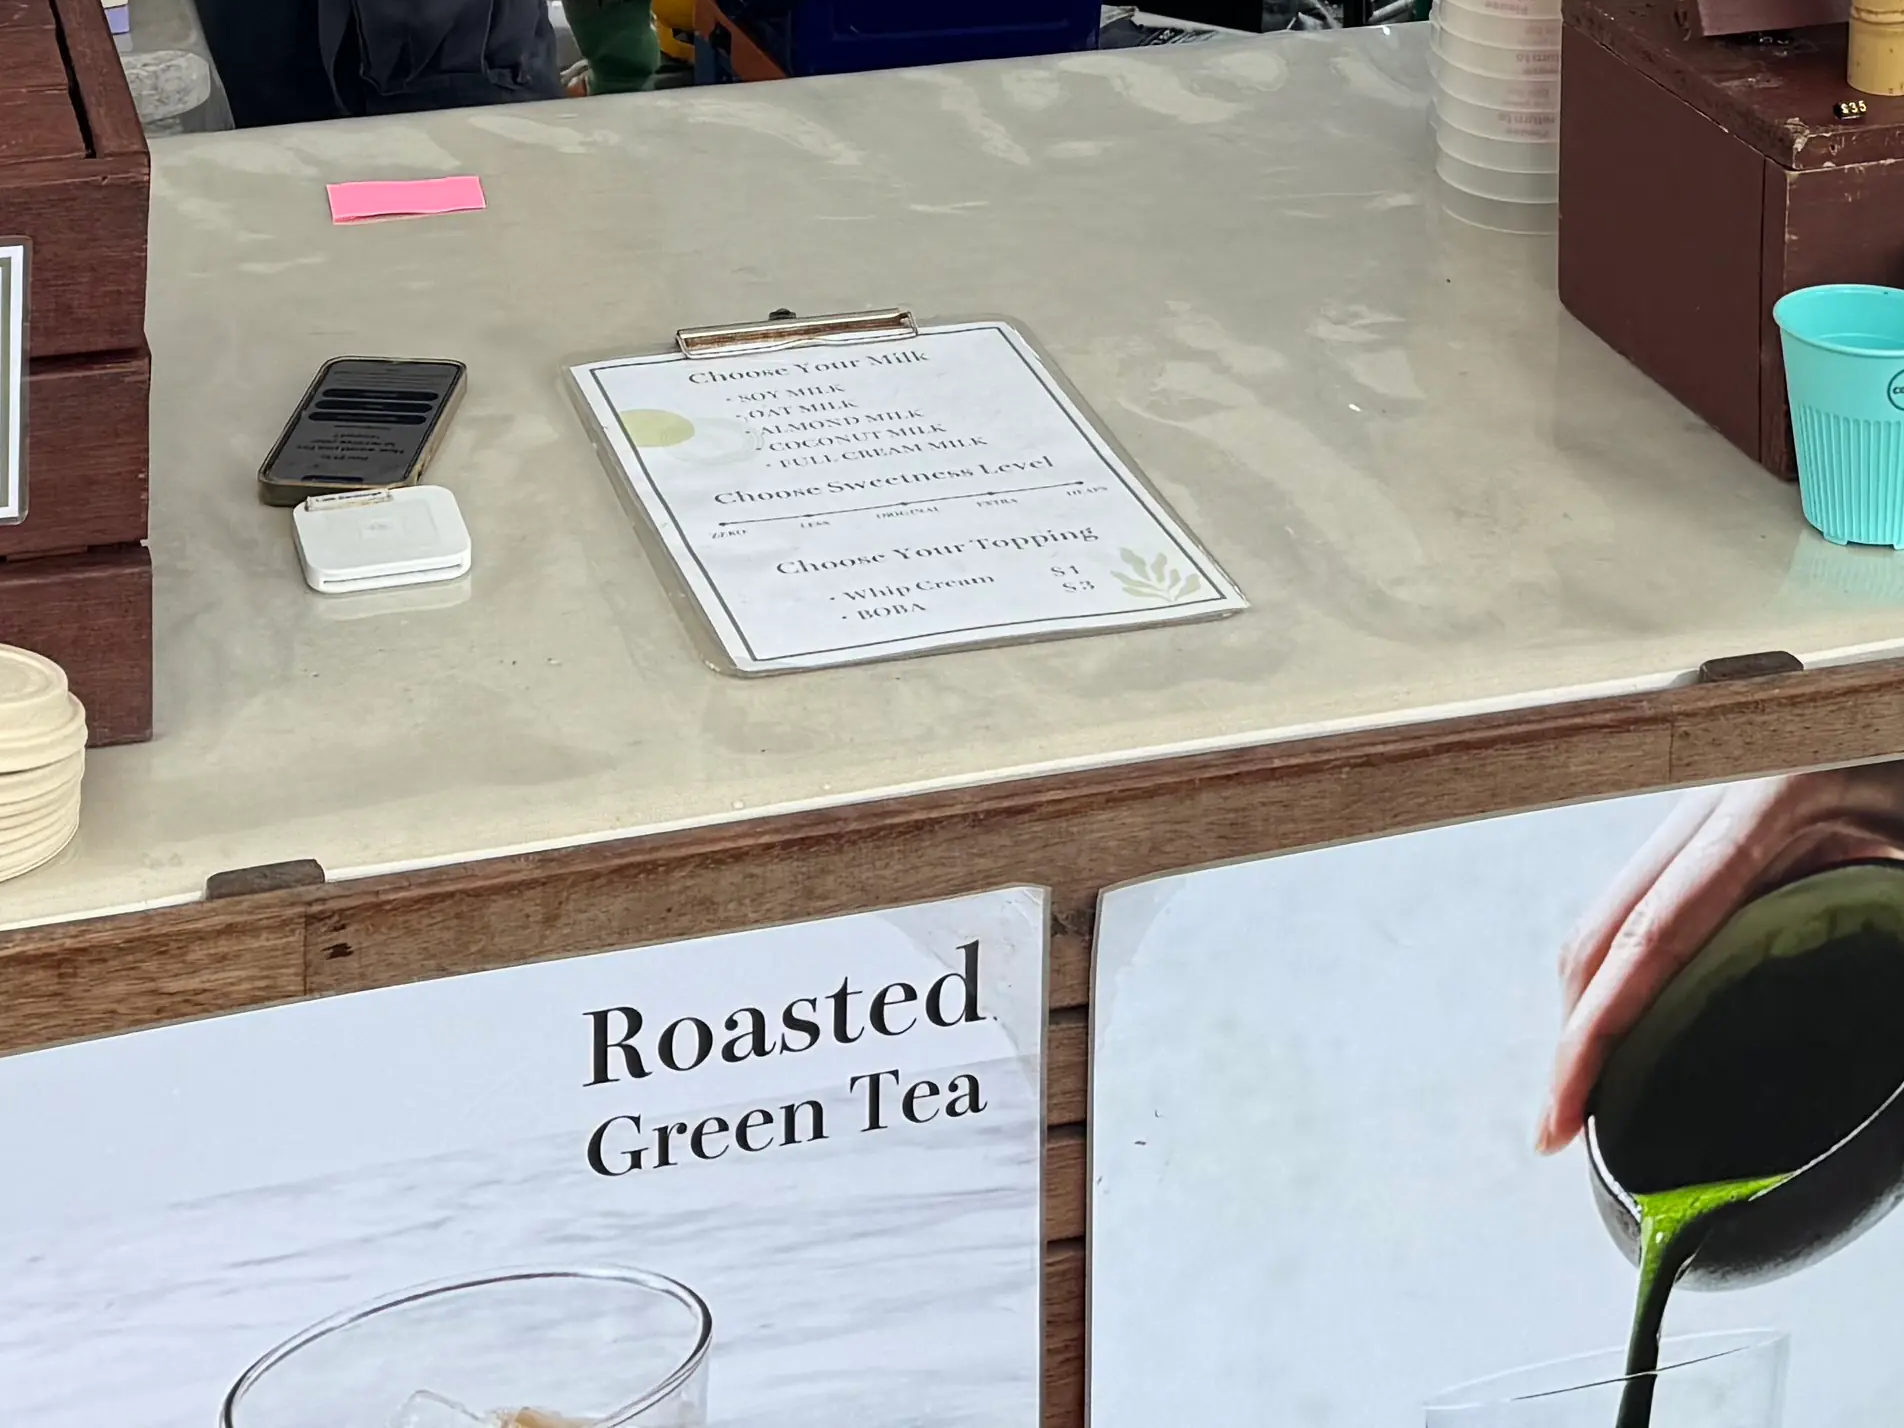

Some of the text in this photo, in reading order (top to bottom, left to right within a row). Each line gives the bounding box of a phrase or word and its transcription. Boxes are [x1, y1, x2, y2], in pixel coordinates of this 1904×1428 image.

[688, 350, 930, 385] Choose Your Milk
[714, 455, 1055, 506] Choose Sweetness Level
[776, 524, 1099, 575] Choose Your Topping
[843, 582, 912, 602] Whip
[915, 574, 995, 592] Cream
[857, 602, 927, 620] BOBA
[581, 940, 986, 1090] Roasted
[586, 1065, 987, 1179] Green Tea
